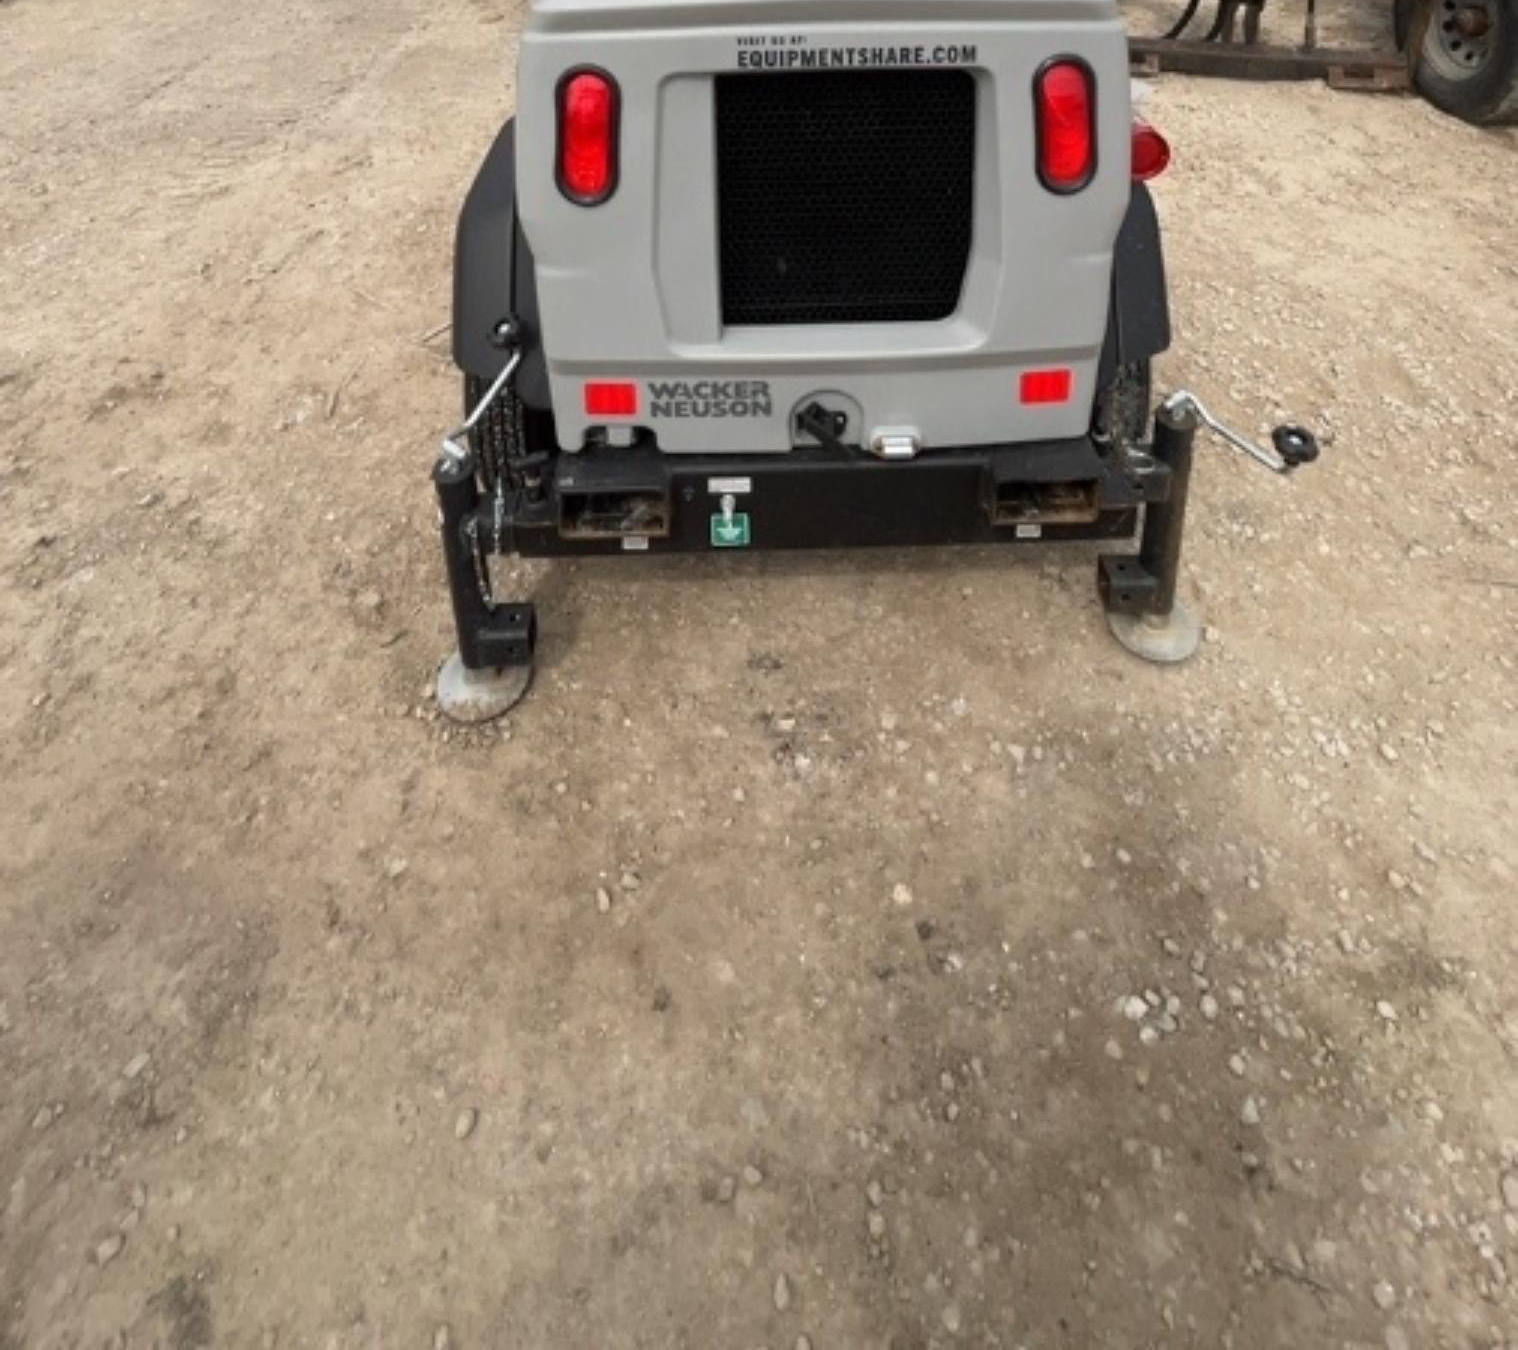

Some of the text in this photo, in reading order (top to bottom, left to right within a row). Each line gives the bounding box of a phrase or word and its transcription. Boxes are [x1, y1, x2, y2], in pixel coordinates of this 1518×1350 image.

[737, 45, 977, 68] EQUIPMENTSHARE.COM
[647, 381, 769, 400] WACKER
[650, 401, 772, 418] NEUSON
